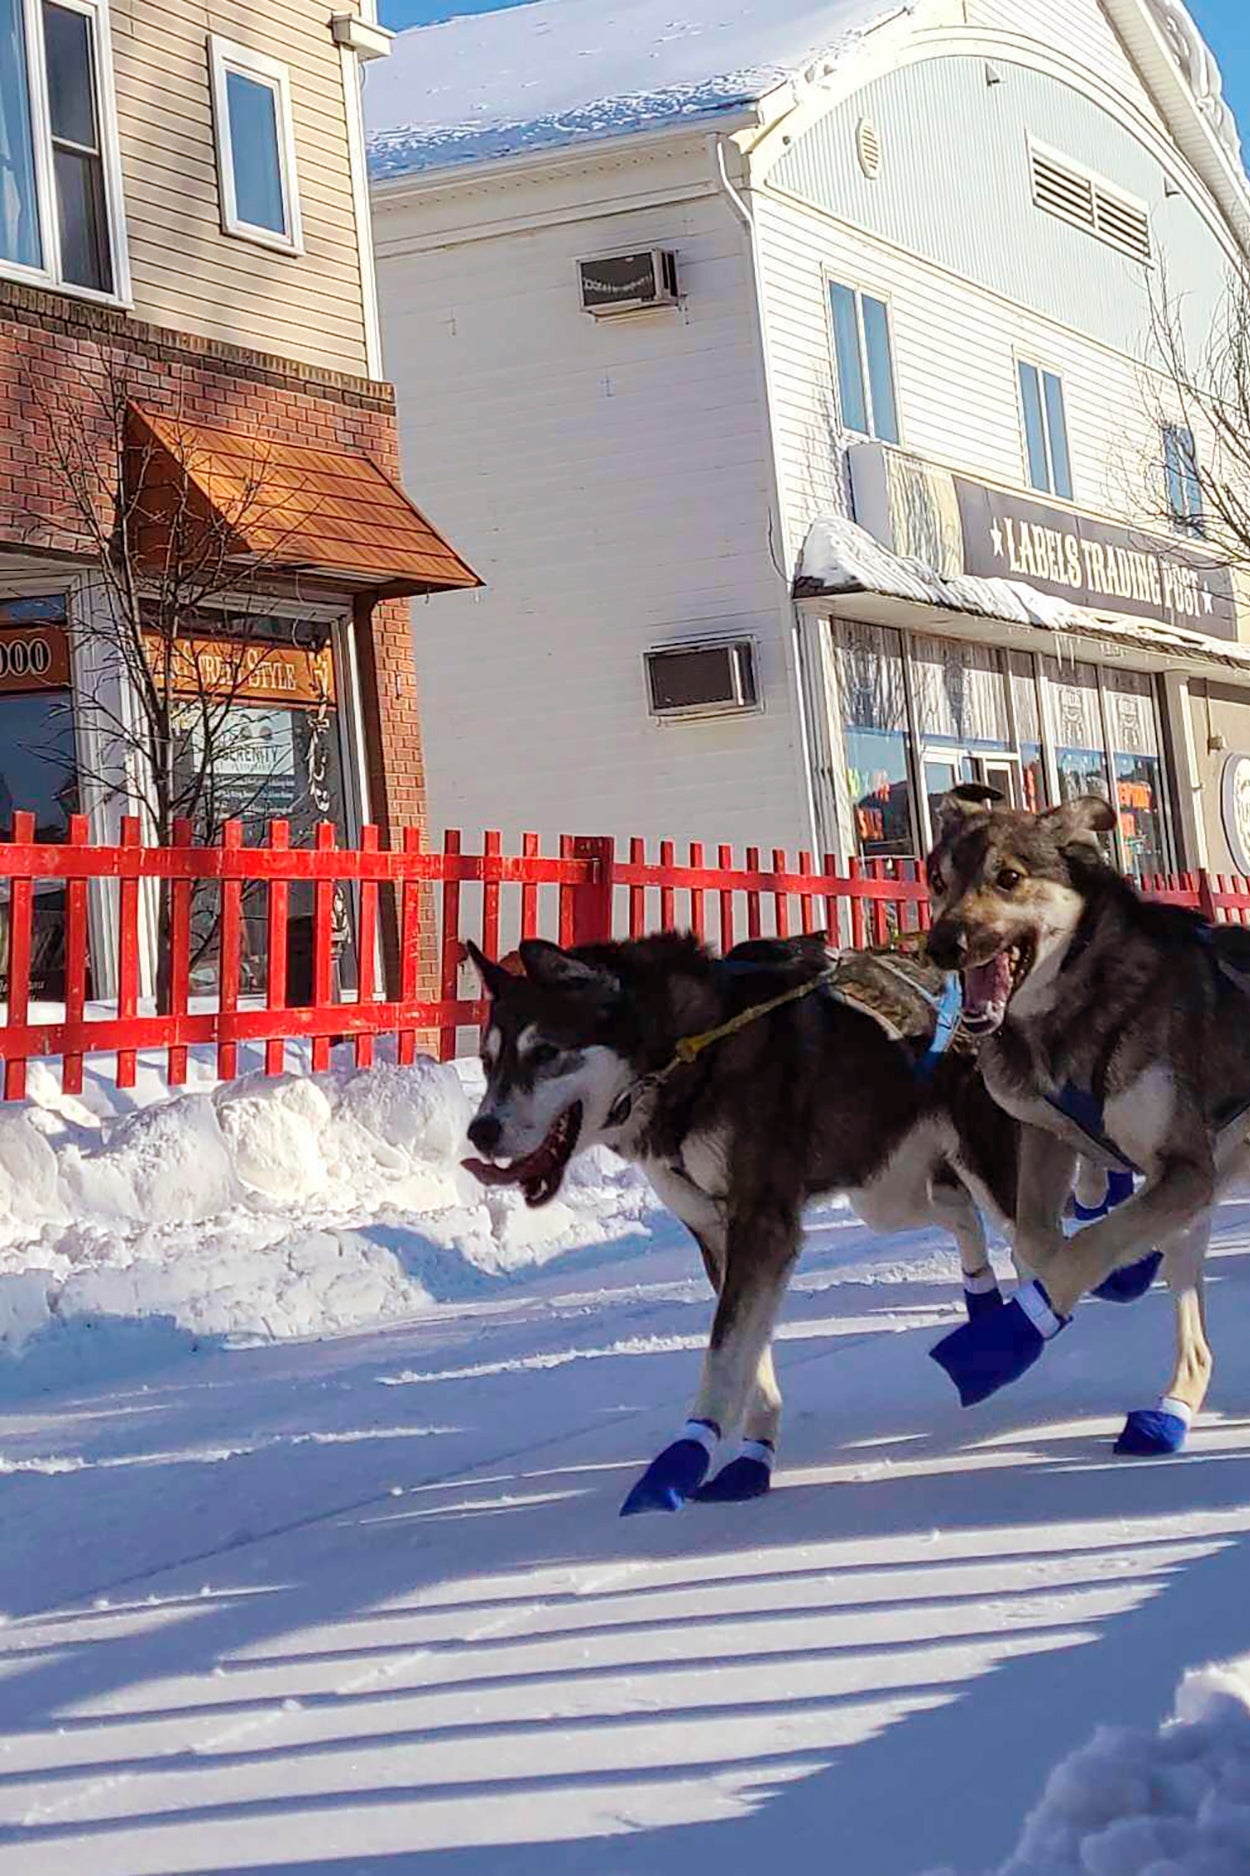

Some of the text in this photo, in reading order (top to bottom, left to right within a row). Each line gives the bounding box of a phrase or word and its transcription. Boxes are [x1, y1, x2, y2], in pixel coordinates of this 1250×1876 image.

[1003, 517, 1200, 617] LABELS TRADING POST
[247, 650, 297, 691] STYLE
